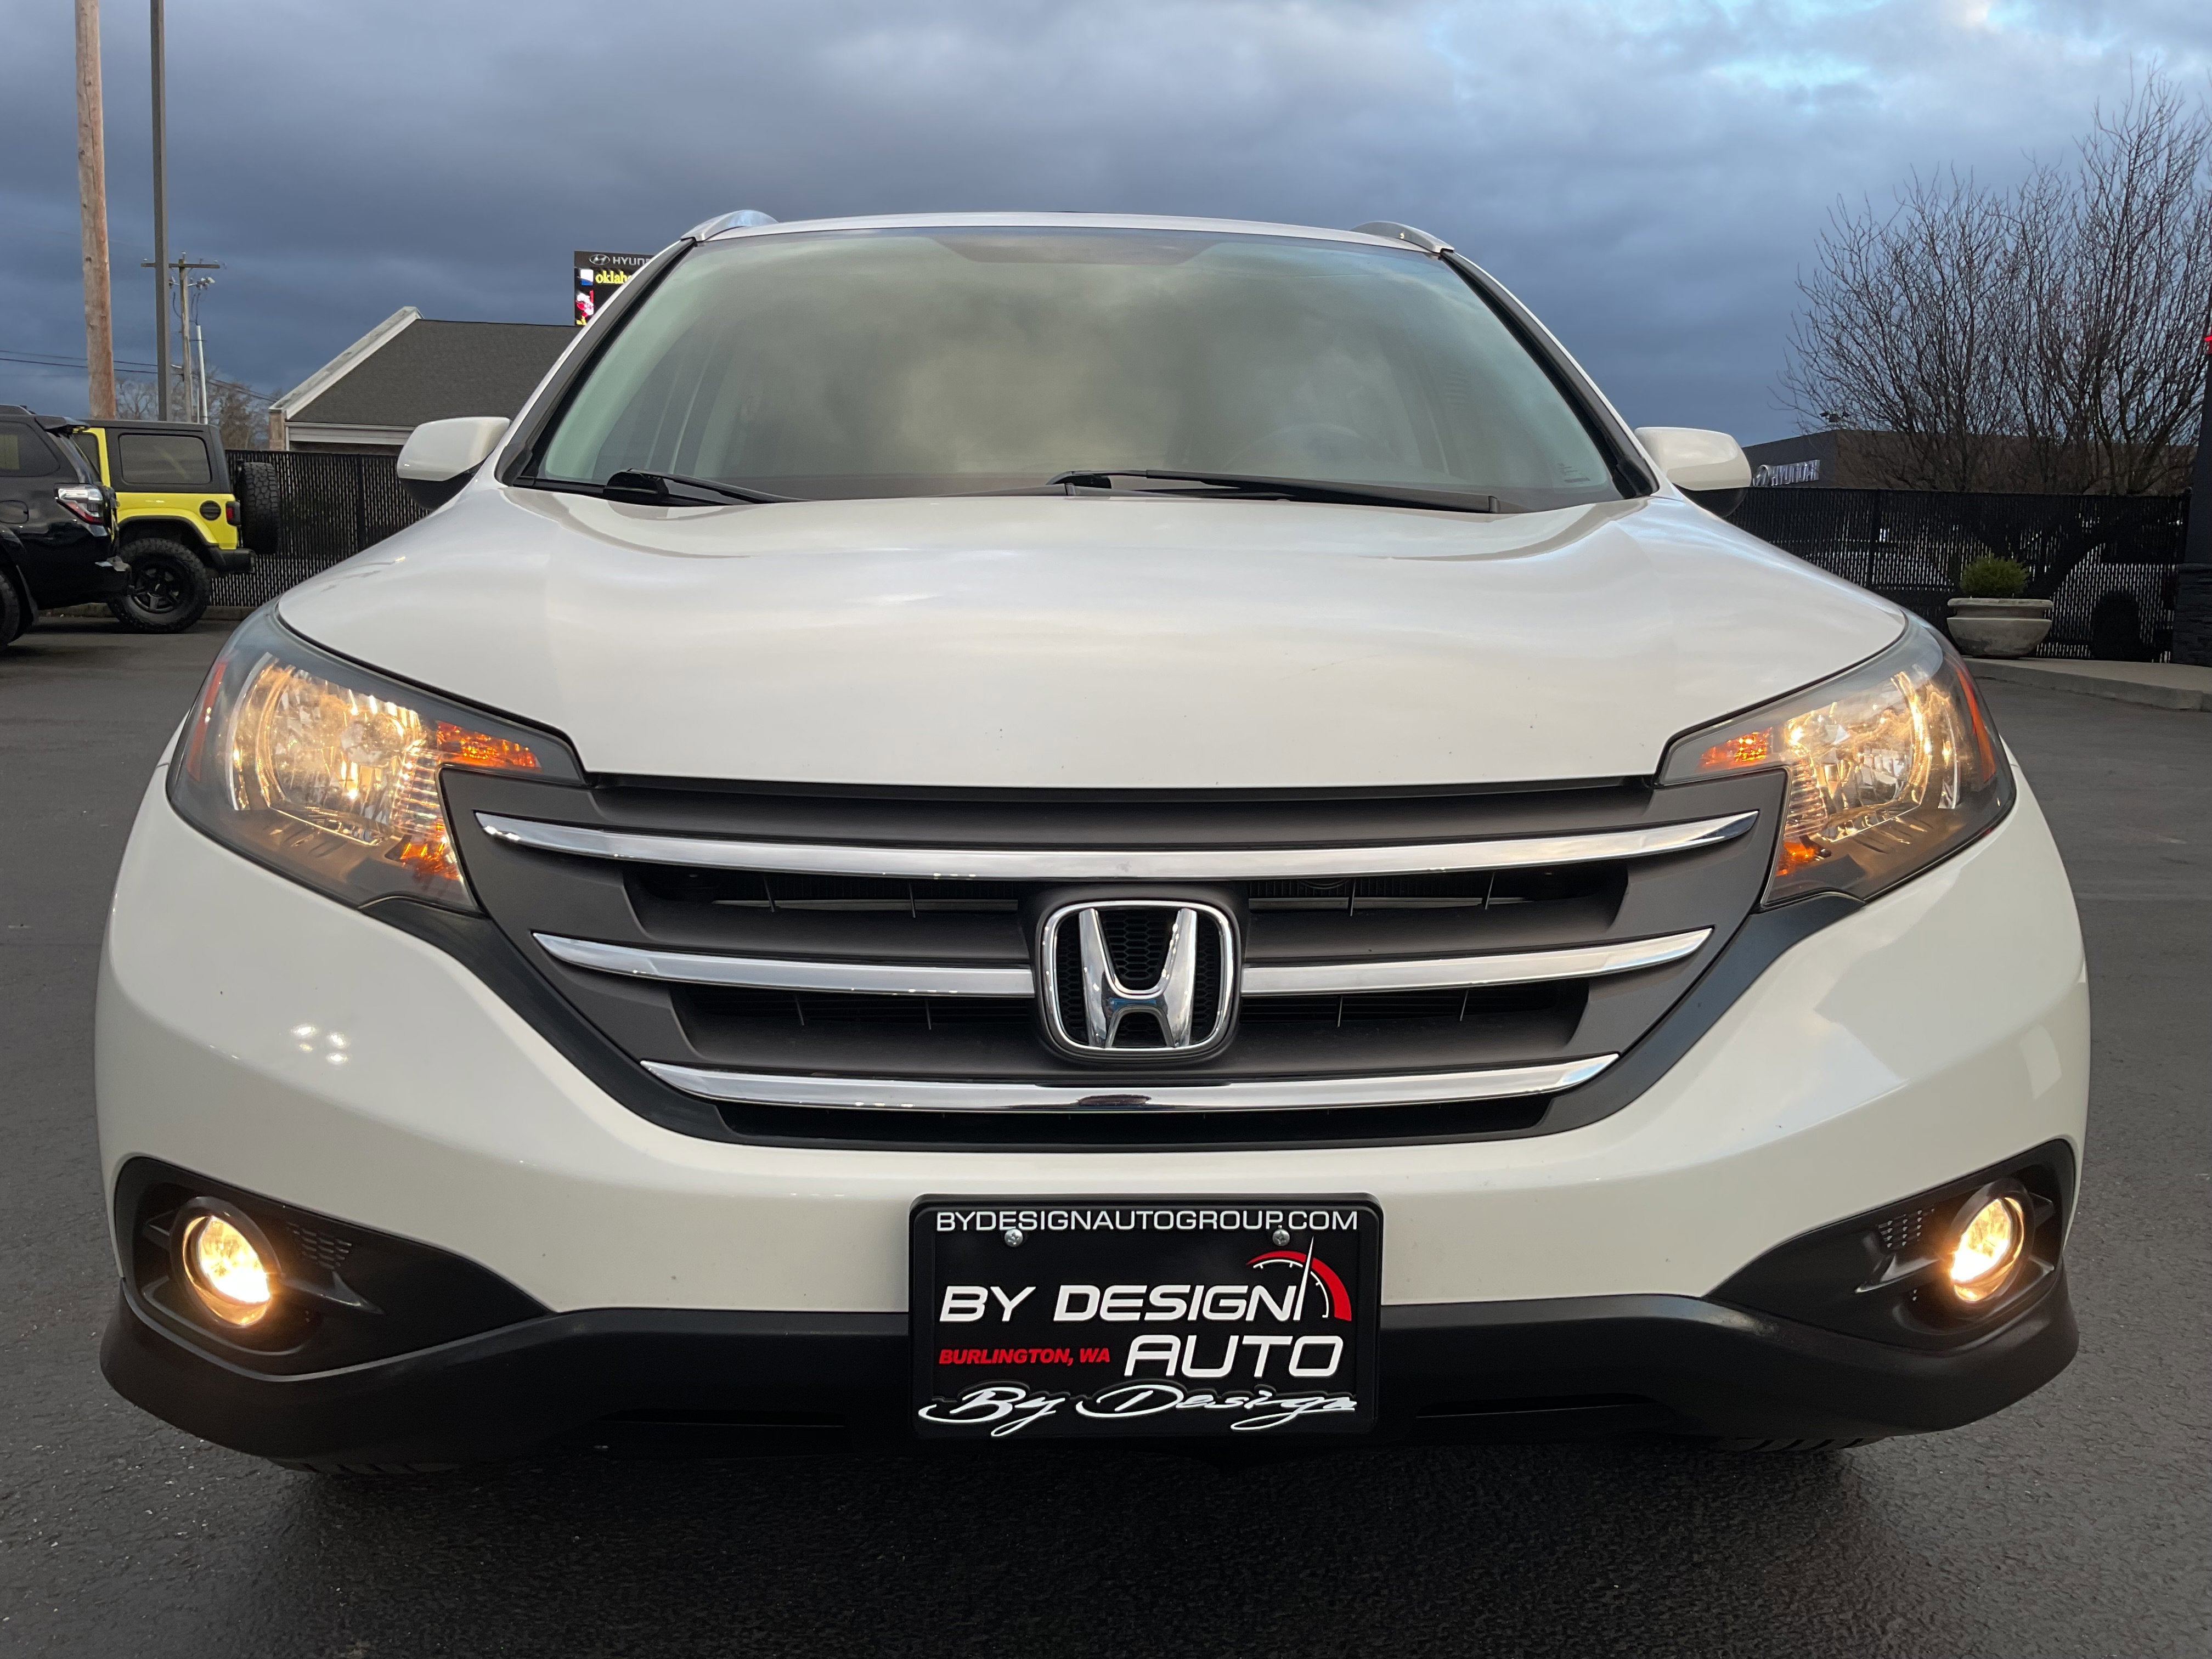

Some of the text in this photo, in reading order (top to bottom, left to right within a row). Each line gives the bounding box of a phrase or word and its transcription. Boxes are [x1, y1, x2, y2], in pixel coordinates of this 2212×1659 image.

[936, 1210, 1358, 1232] BYDESIGNAUTOGROUP.COM
[939, 1284, 1297, 1323] BY DESIGN
[938, 1347, 1111, 1367] BURLINGTON, WA
[1123, 1334, 1344, 1378] AUTO
[917, 1384, 1358, 1437] By Design
